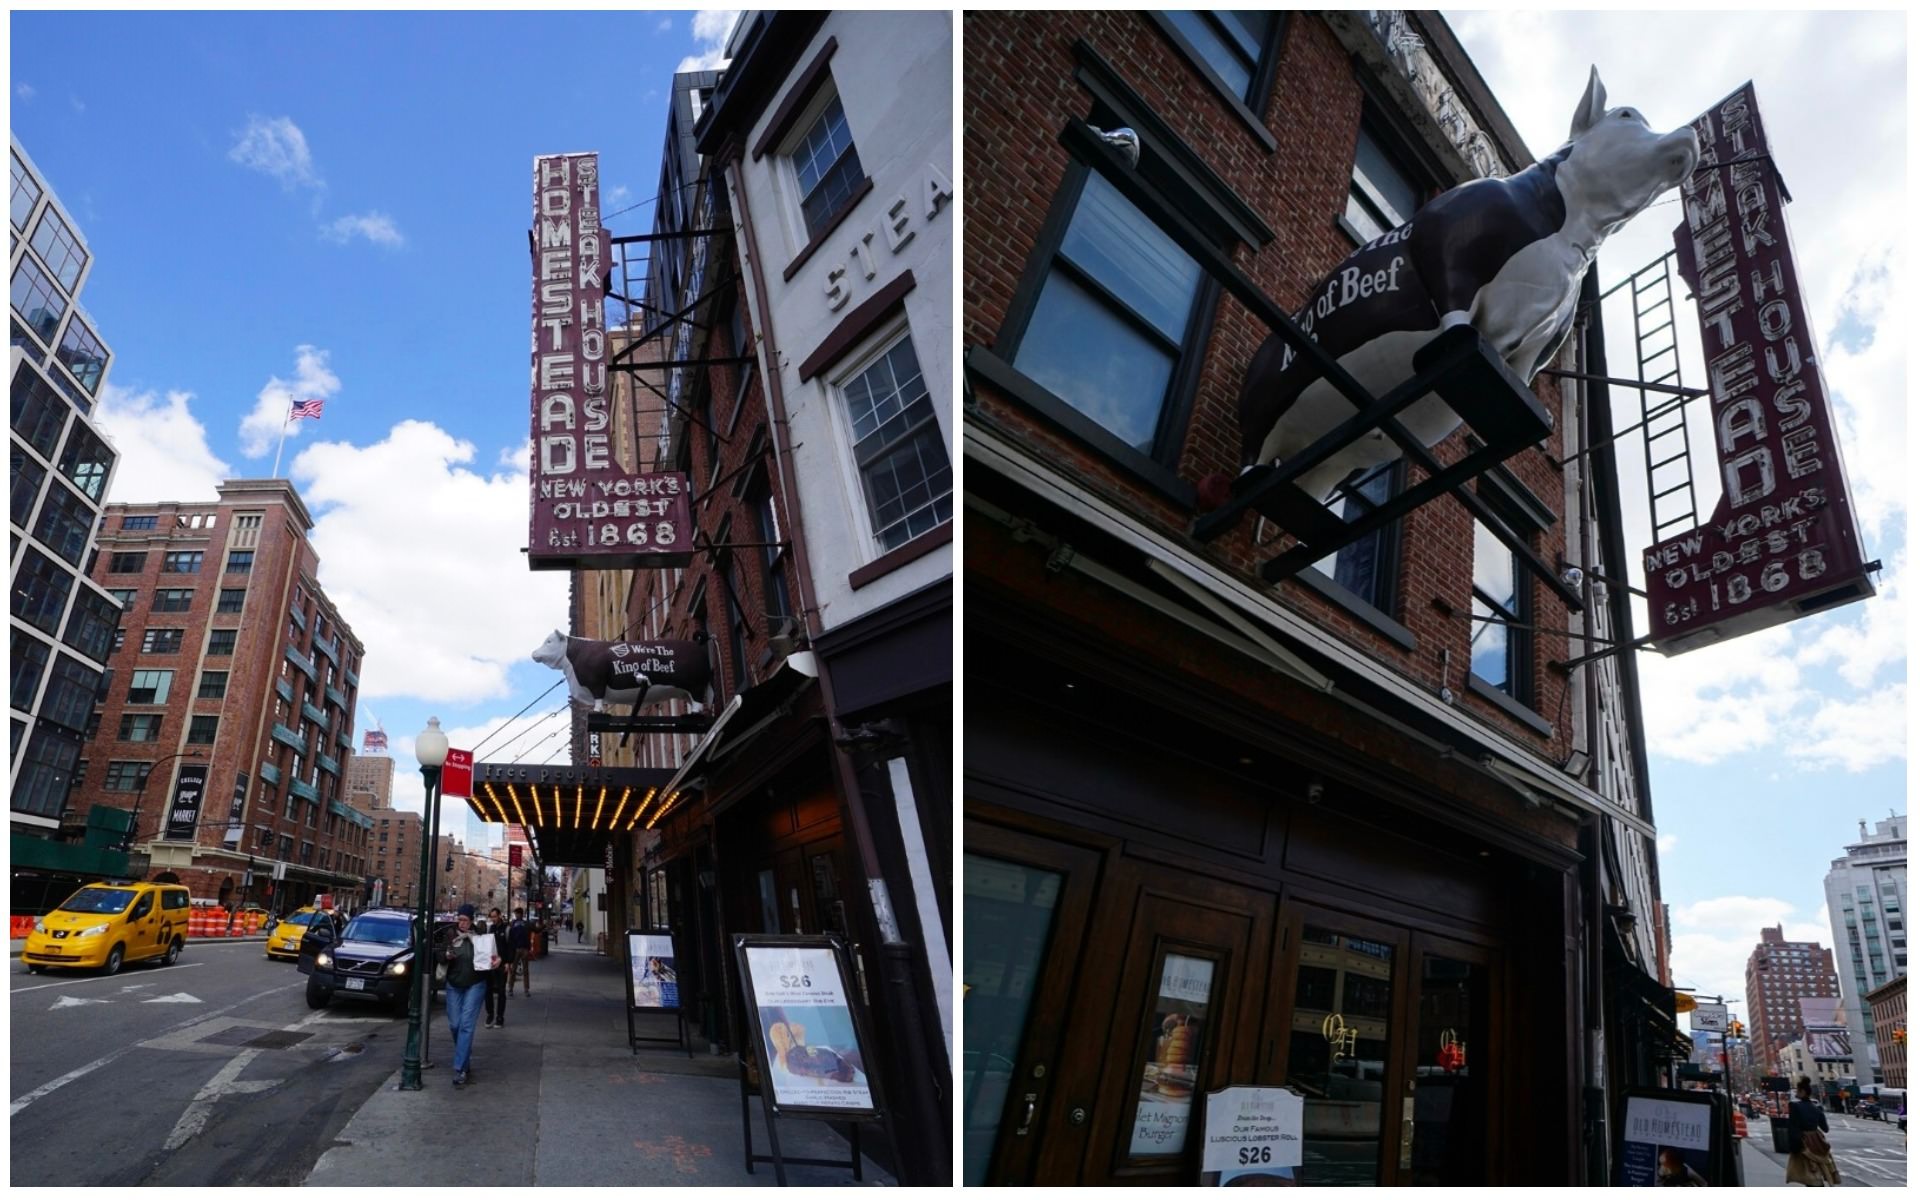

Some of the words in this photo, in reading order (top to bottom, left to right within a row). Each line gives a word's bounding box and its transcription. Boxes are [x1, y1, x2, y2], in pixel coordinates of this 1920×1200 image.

[576, 158, 601, 289] STEAK
[1316, 279, 1338, 319] of
[1338, 256, 1404, 308] Beef
[1720, 92, 1778, 258] STEAK
[1750, 259, 1823, 479] HOUSE
[541, 157, 577, 475] HOMESTEAD
[580, 299, 610, 470] HOUSE
[540, 478, 587, 498] NEW
[553, 498, 673, 519] OLDEST
[587, 522, 676, 546] 1868
[1646, 534, 1703, 573] NEW
[1665, 516, 1818, 589] OLDEST
[1709, 549, 1827, 611] 1868
[655, 645, 674, 656] The
[612, 660, 639, 677] King
[641, 658, 652, 672] of
[652, 657, 675, 673] Beef
[485, 762, 527, 778] free
[172, 809, 197, 823] MARKET
[780, 974, 812, 988] $26
[1138, 1127, 1176, 1144] Burger
[1633, 1117, 1649, 1132] OLD
[1651, 1118, 1701, 1138] HOMESTEAD
[1239, 1146, 1271, 1166] $26
